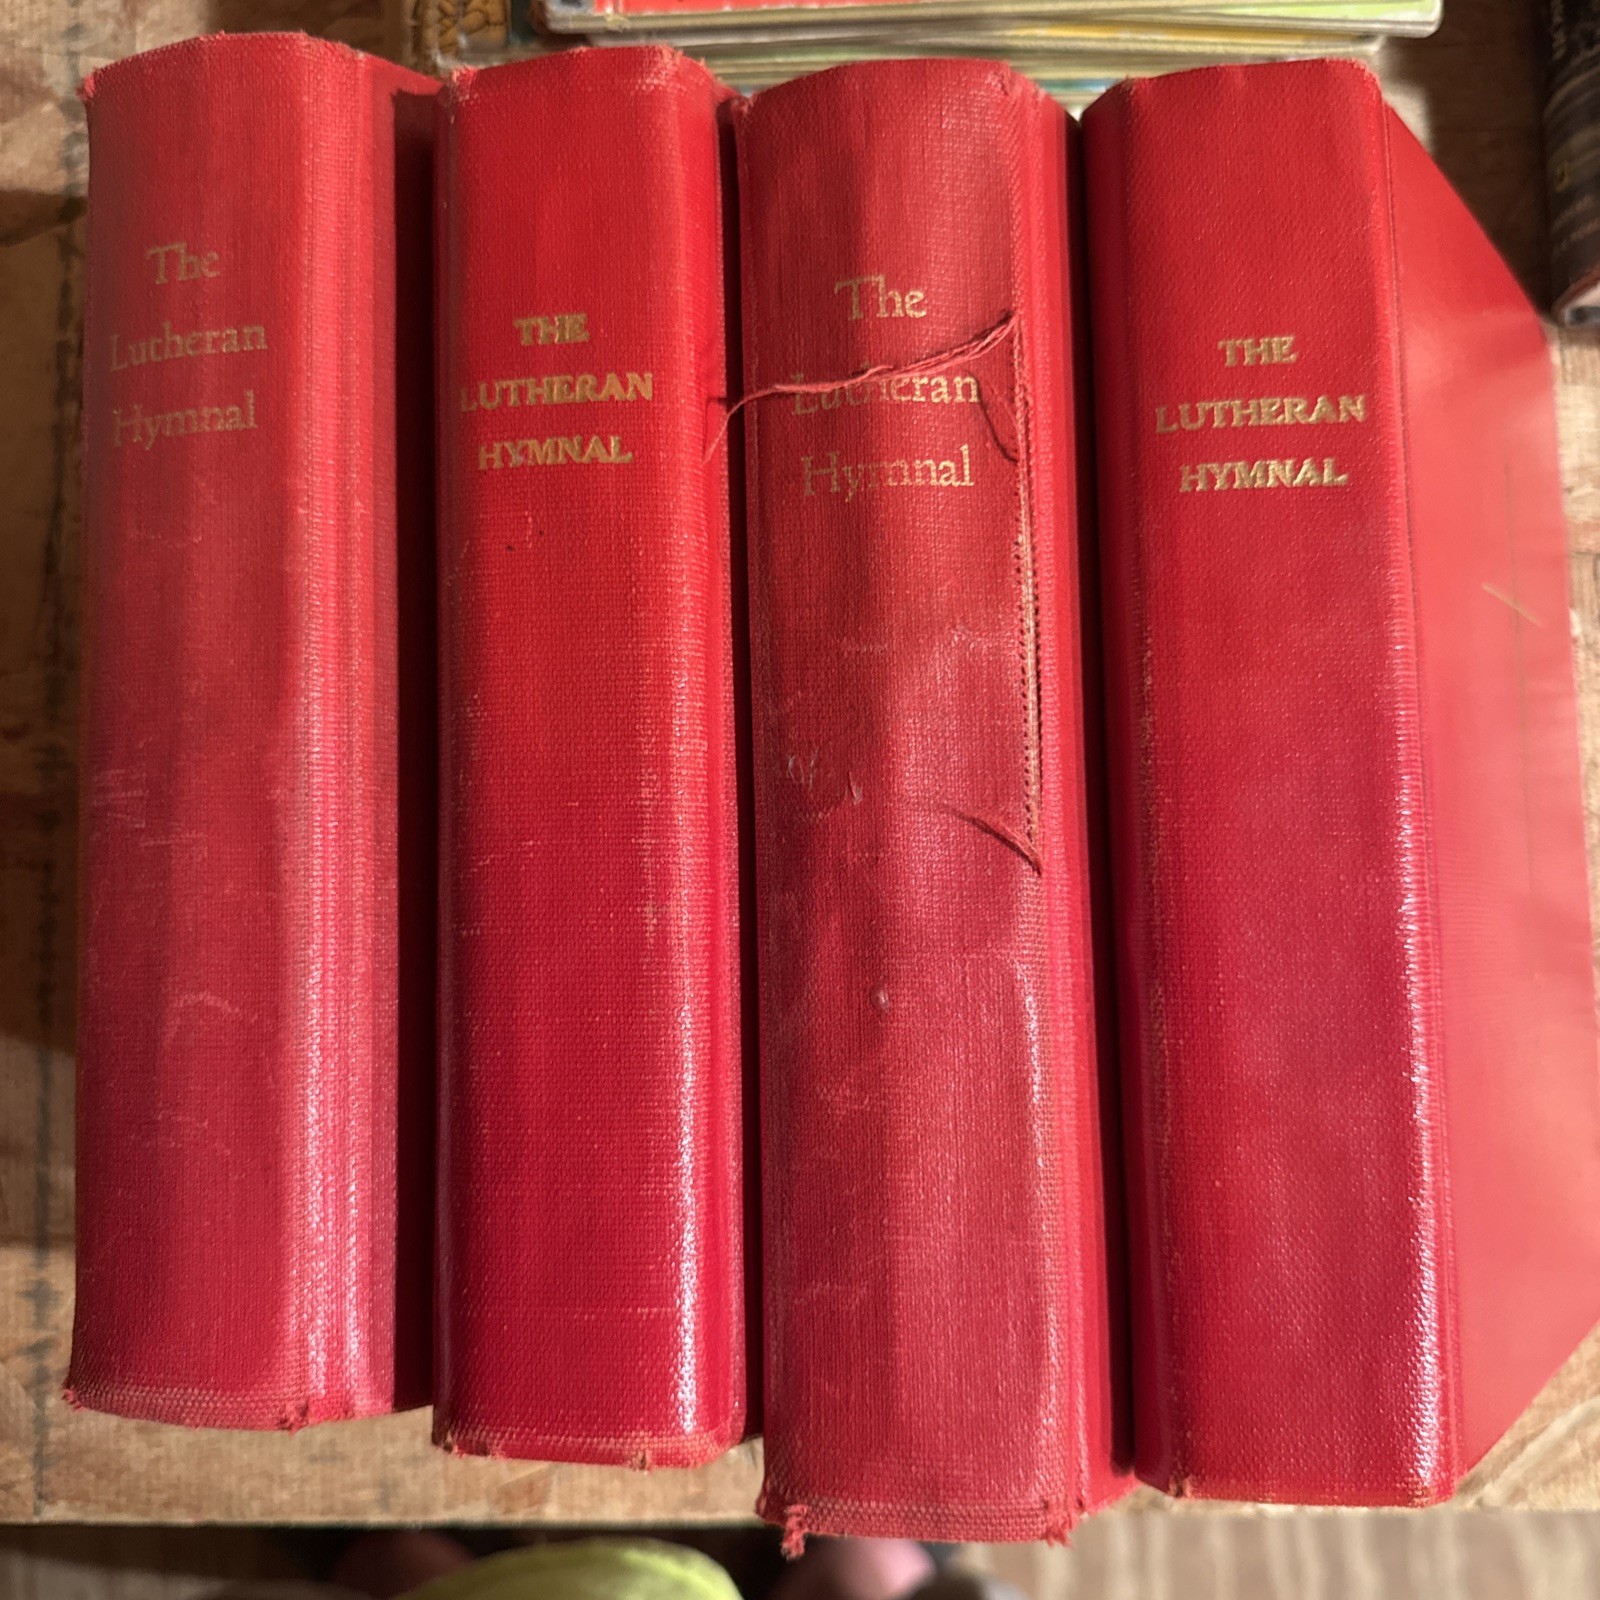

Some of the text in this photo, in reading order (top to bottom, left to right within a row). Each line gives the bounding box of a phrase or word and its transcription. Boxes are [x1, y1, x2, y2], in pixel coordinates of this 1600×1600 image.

[145, 241, 220, 285] The
[834, 274, 927, 321] The
[109, 320, 268, 373] Lutheran
[513, 312, 590, 346] THE
[1217, 335, 1298, 367] THE
[461, 372, 653, 412] LUTHERAN
[112, 388, 258, 450] Hymnal
[1155, 394, 1366, 433] LUTHERAN
[478, 434, 633, 471] HYMNAL
[801, 444, 975, 502] Hymnal
[1179, 457, 1348, 493] HYMNAL
